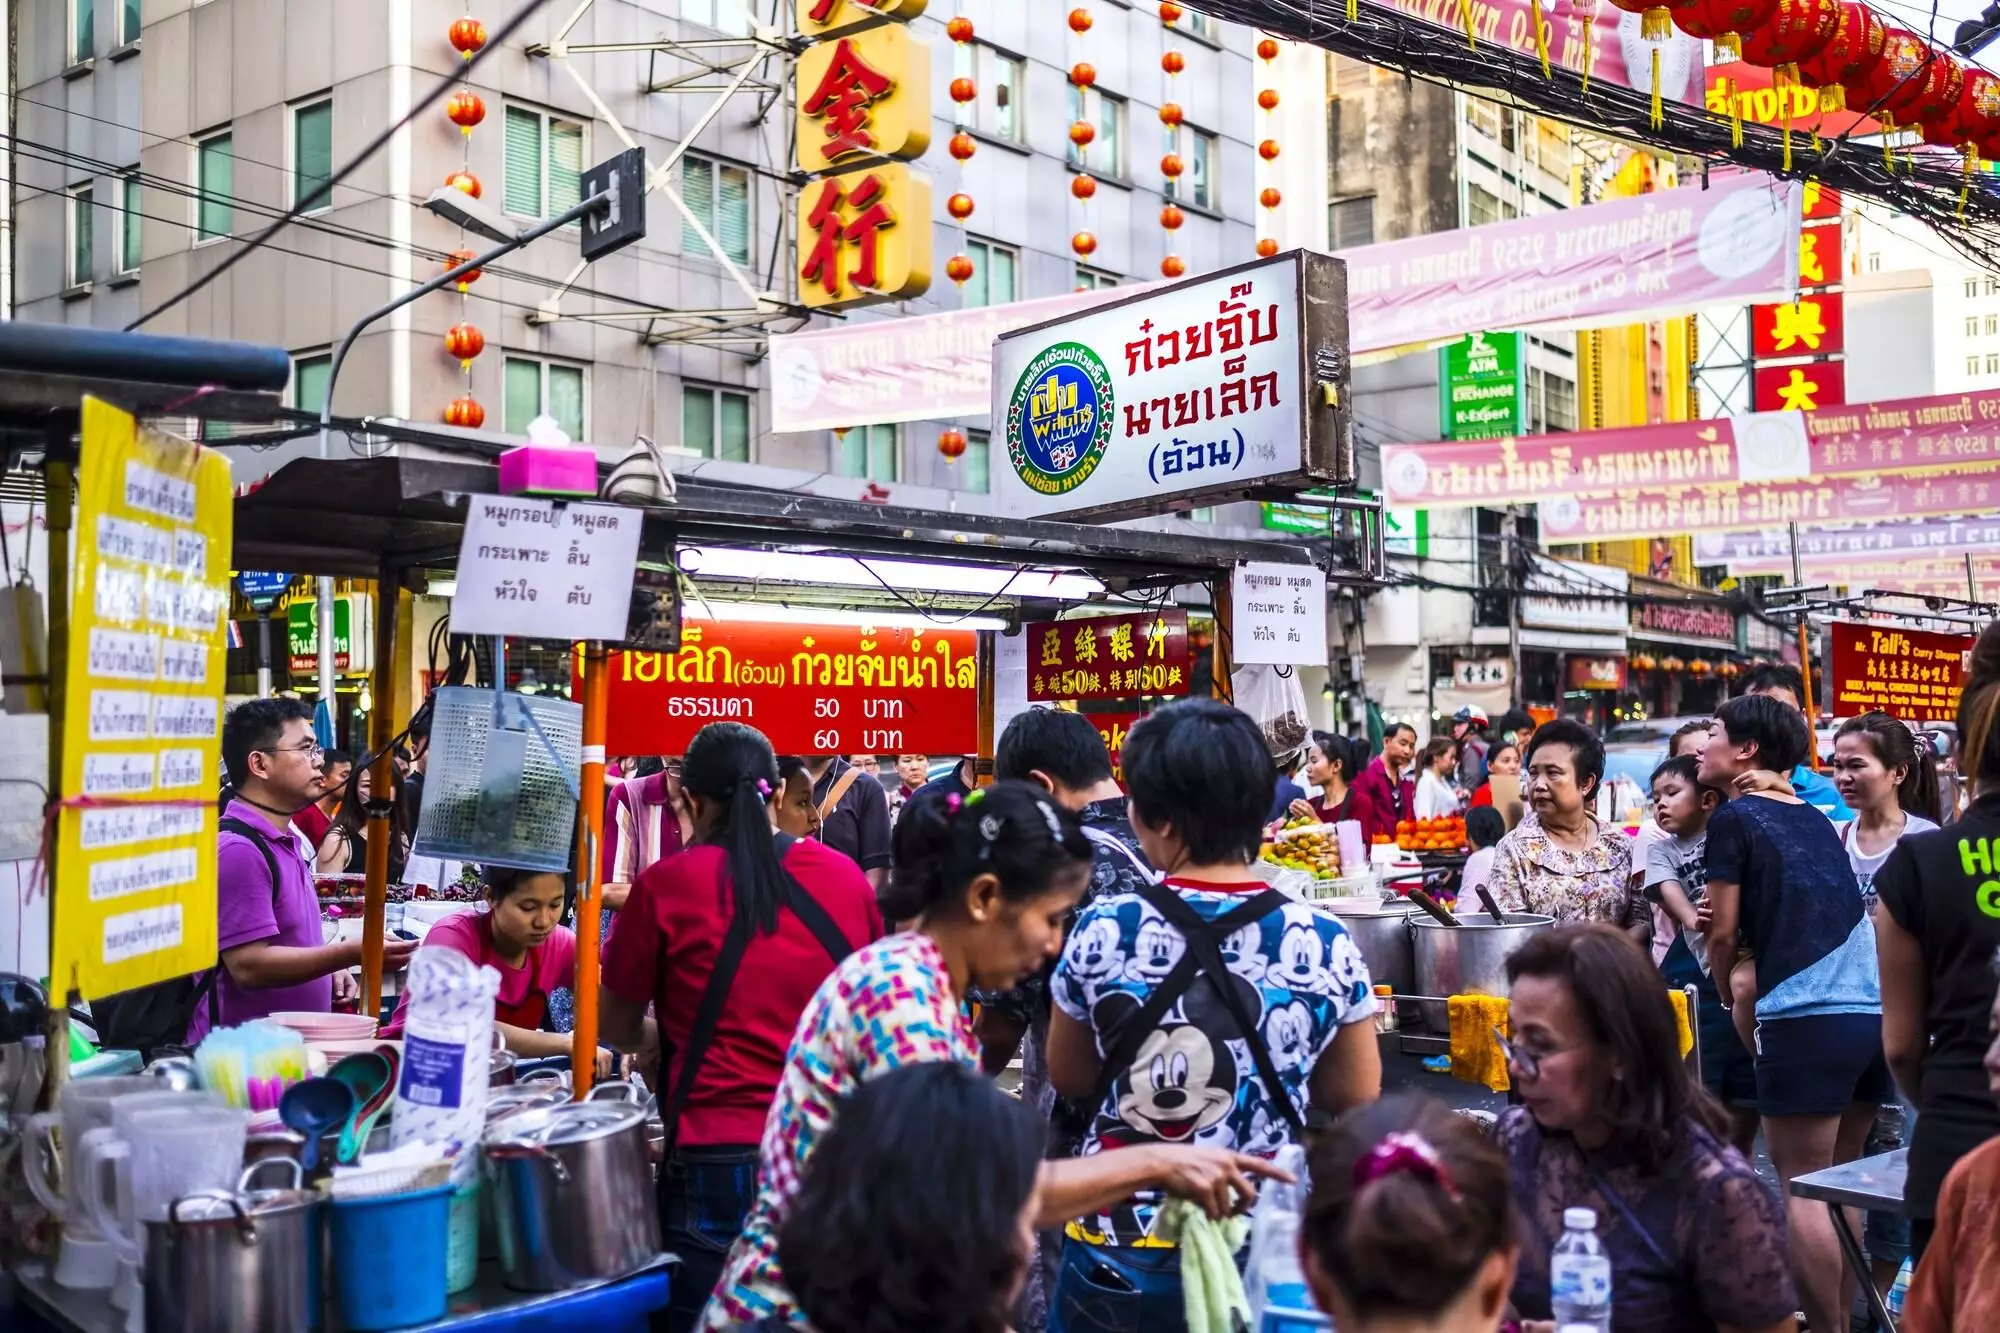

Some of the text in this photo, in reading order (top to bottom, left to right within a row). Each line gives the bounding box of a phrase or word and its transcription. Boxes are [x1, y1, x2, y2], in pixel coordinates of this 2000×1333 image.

[1124, 281, 1279, 376] ก๋วยจั๊บ
[1468, 358, 1499, 374] ATM
[1123, 354, 1281, 438] นายเล็ก
[1453, 384, 1515, 402] EXCHANGE
[1147, 427, 1246, 485] (อ้วน)
[572, 512, 620, 535] หมูสด
[478, 539, 591, 567] กระเพาะ ลิ้น
[495, 578, 593, 606] หัวใจ ตับ
[1244, 573, 1312, 592] หมูกรอบ หมูสด
[1247, 597, 1306, 616] กระเพาะ ลิ้น
[1253, 626, 1301, 642] หัวใจ ตับ
[1854, 641, 1868, 653] Mr.
[1871, 630, 1911, 656] Tall's
[791, 624, 977, 689] ก๋วยจั๊บน้ำใส
[668, 697, 904, 719] ธรรมดา 50 บาท
[813, 729, 904, 750] 60 บาท
